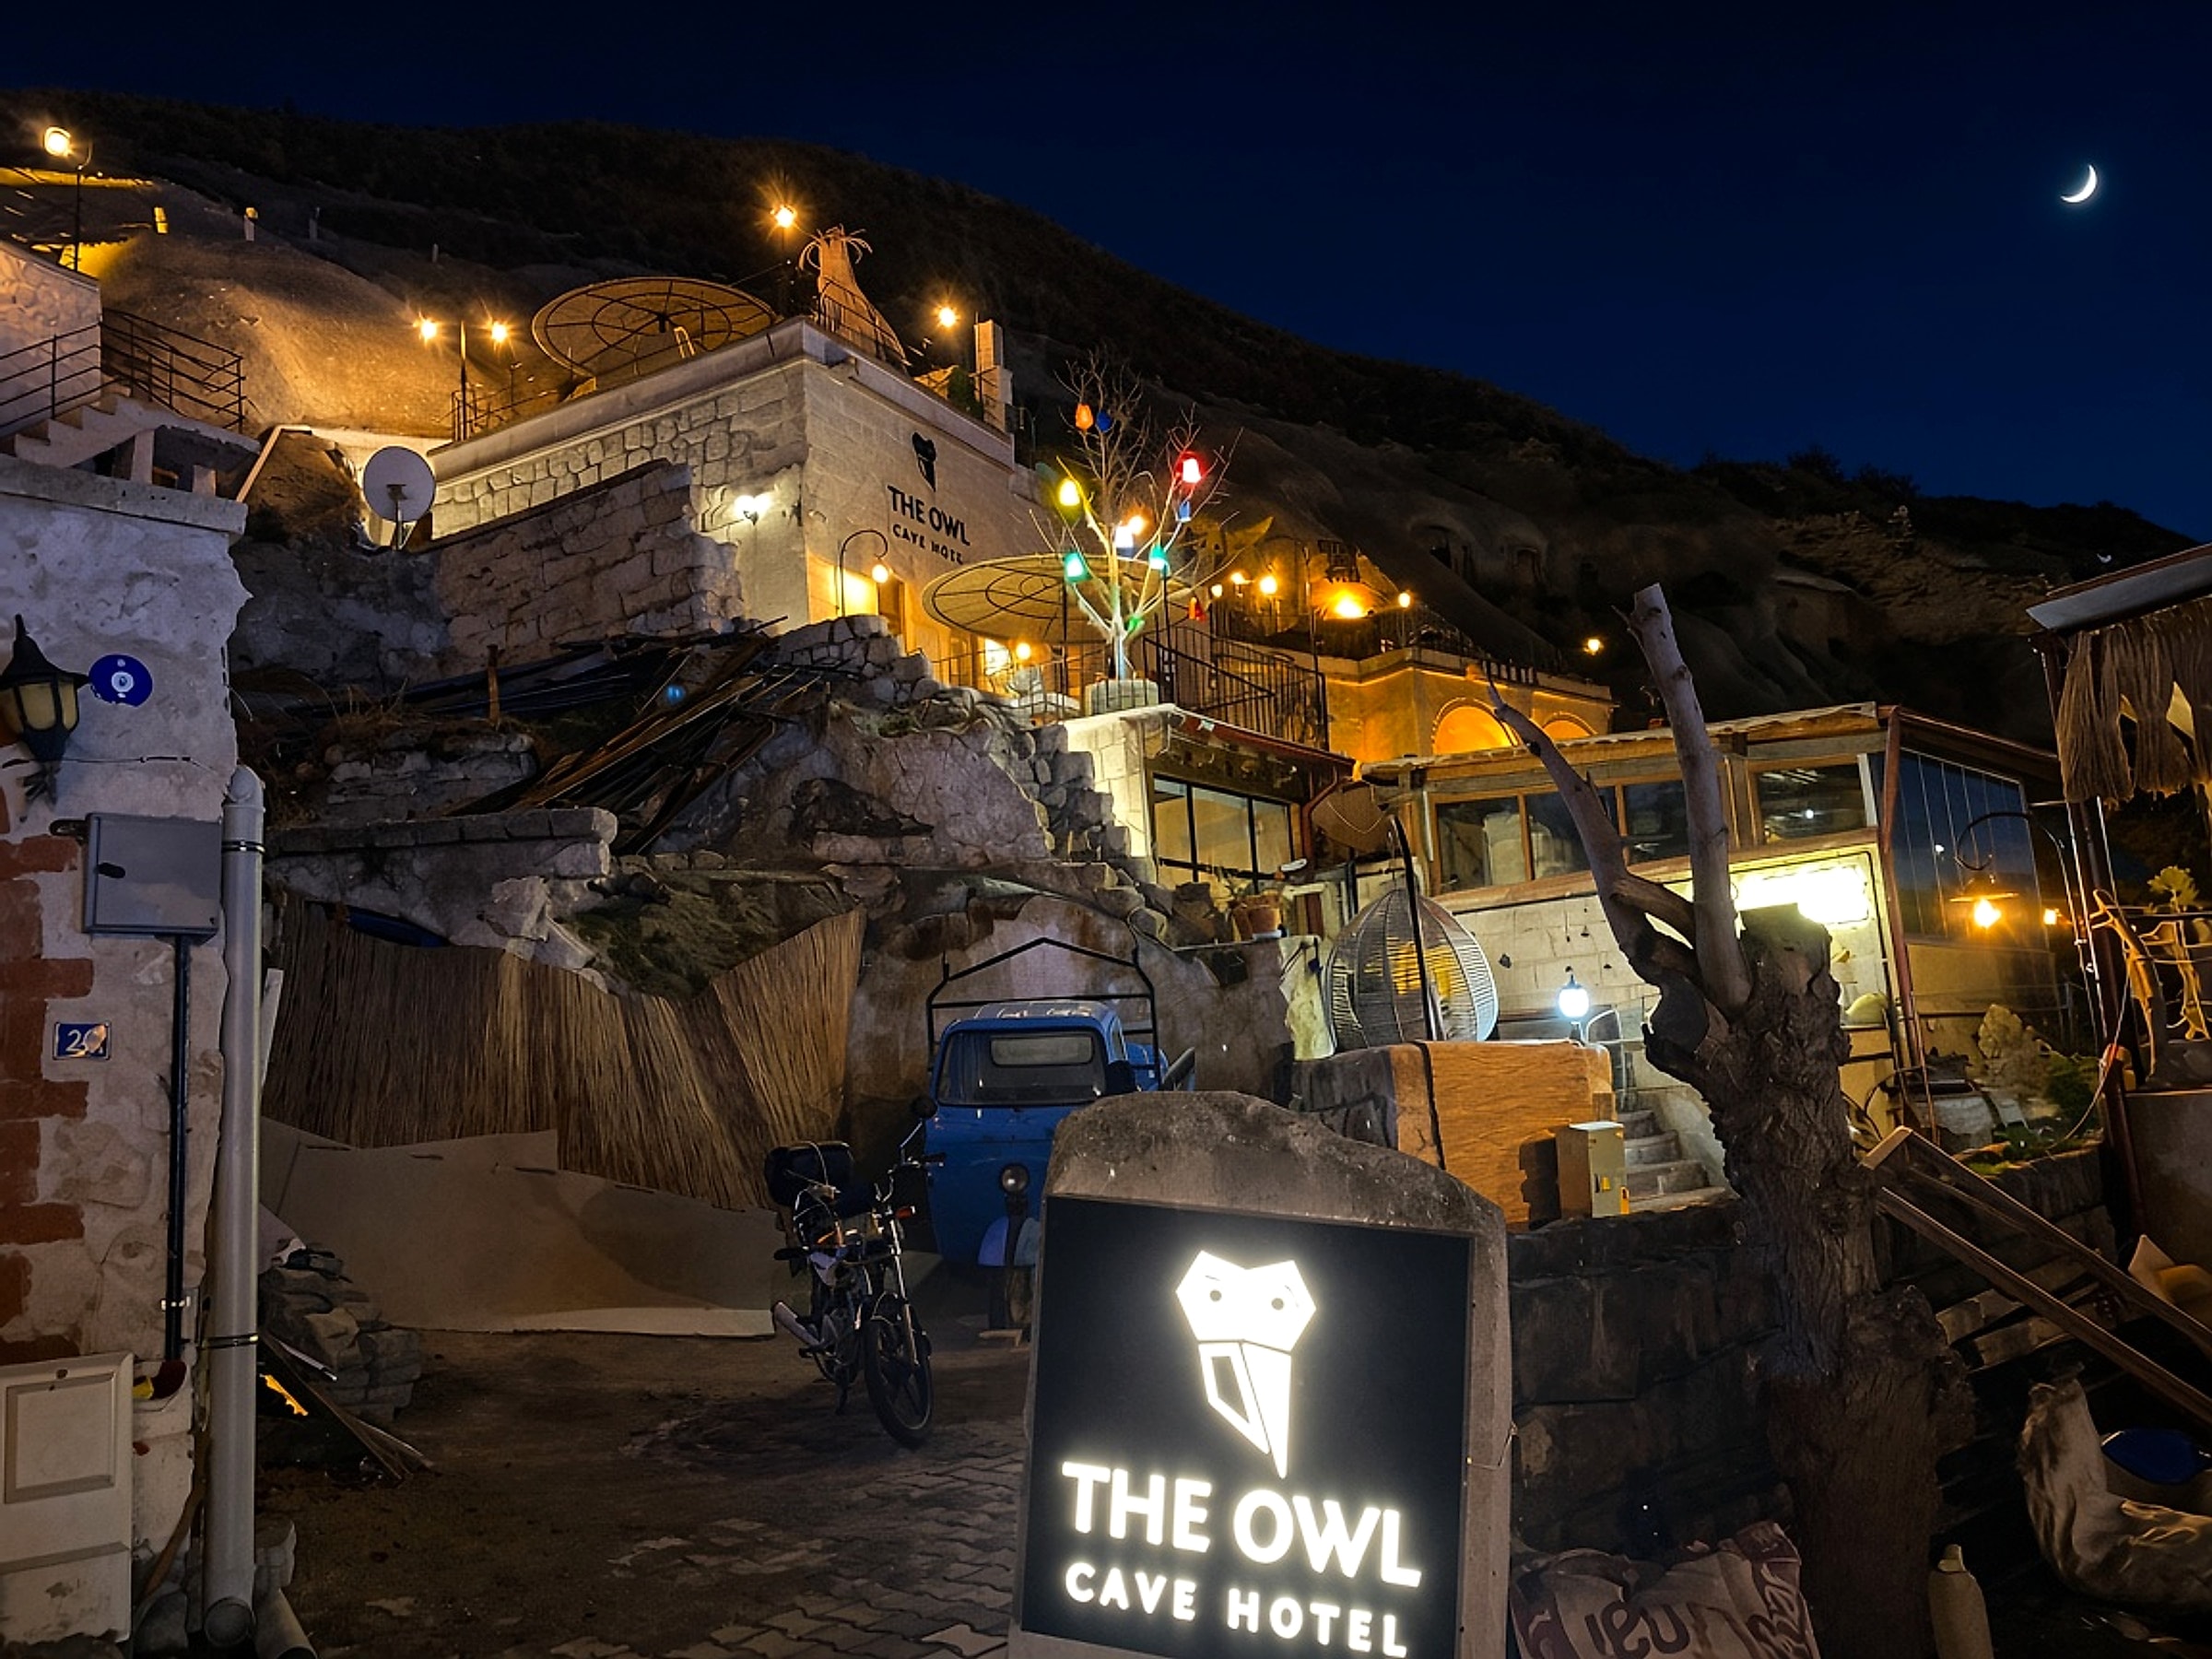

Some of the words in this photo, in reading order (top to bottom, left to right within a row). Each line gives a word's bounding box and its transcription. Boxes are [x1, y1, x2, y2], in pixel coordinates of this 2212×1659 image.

[887, 485, 925, 524] THE
[929, 506, 971, 546] OWL
[1061, 1462, 1212, 1553] THE
[1233, 1489, 1422, 1588] OWL
[1065, 1562, 1197, 1621] CAVE
[1227, 1588, 1408, 1658] HOTEL
